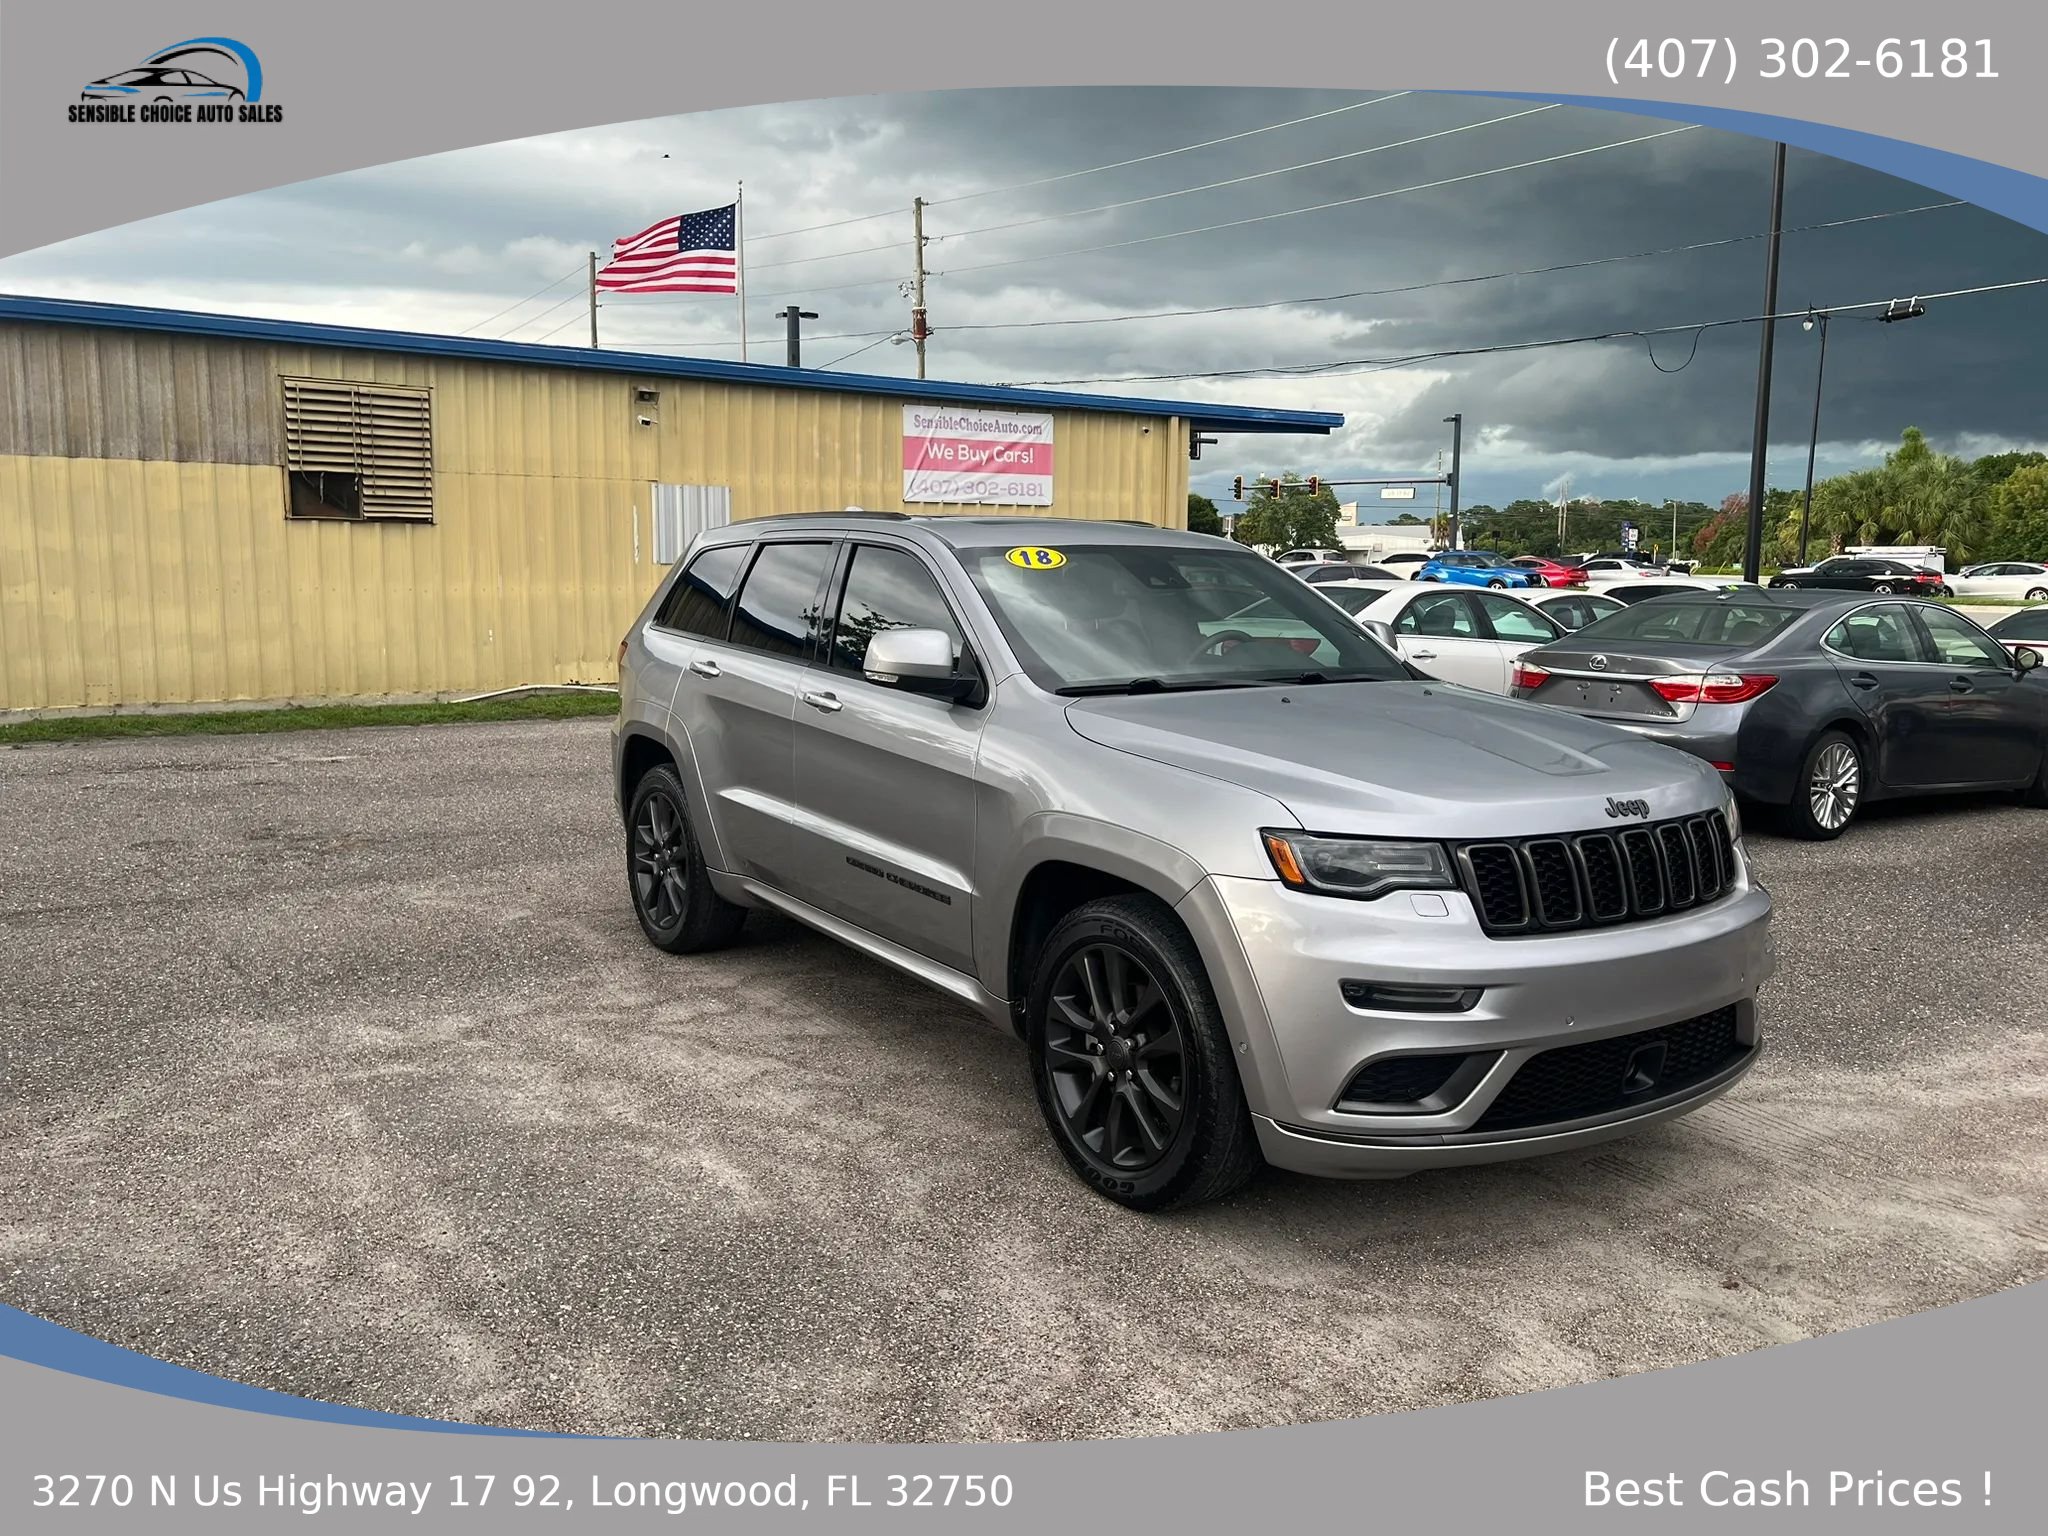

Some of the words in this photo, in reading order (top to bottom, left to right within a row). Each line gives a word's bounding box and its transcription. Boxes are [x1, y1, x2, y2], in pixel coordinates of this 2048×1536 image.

[913, 413, 1043, 436] SensibleChoiceAuto.com
[926, 442, 954, 461] We
[958, 444, 989, 466] Buy
[993, 446, 1034, 464] Cars!
[911, 479, 959, 497] (407)
[963, 481, 1044, 497] 302-6181
[1019, 549, 1053, 566] 18
[1604, 797, 1650, 819] Jeep
